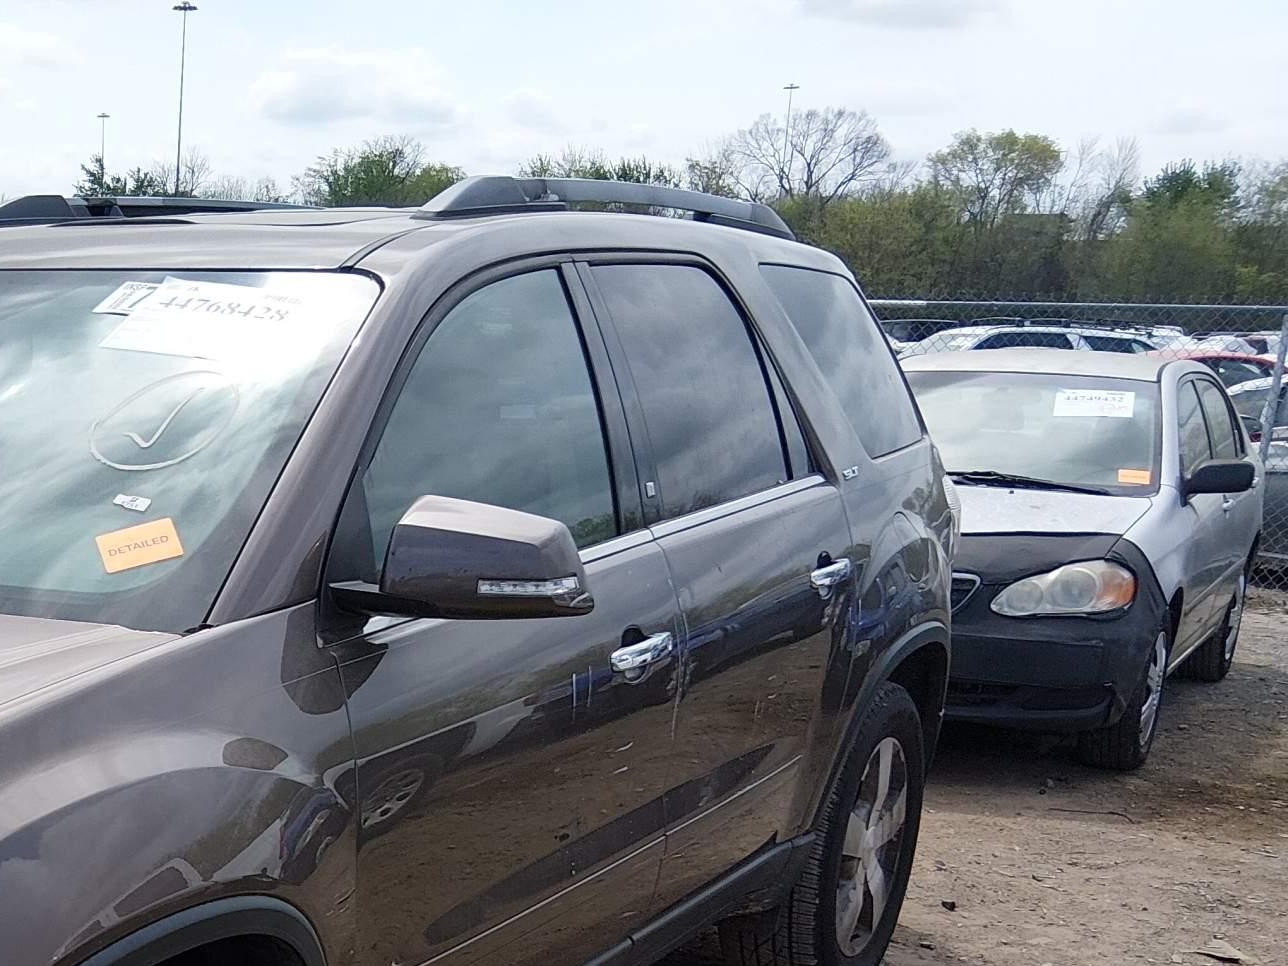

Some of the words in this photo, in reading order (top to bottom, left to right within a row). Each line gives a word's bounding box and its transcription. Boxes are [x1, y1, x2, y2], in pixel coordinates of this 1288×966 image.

[159, 294, 291, 322] 44768428
[842, 465, 859, 480] SLT
[107, 535, 169, 557] DETAILED
